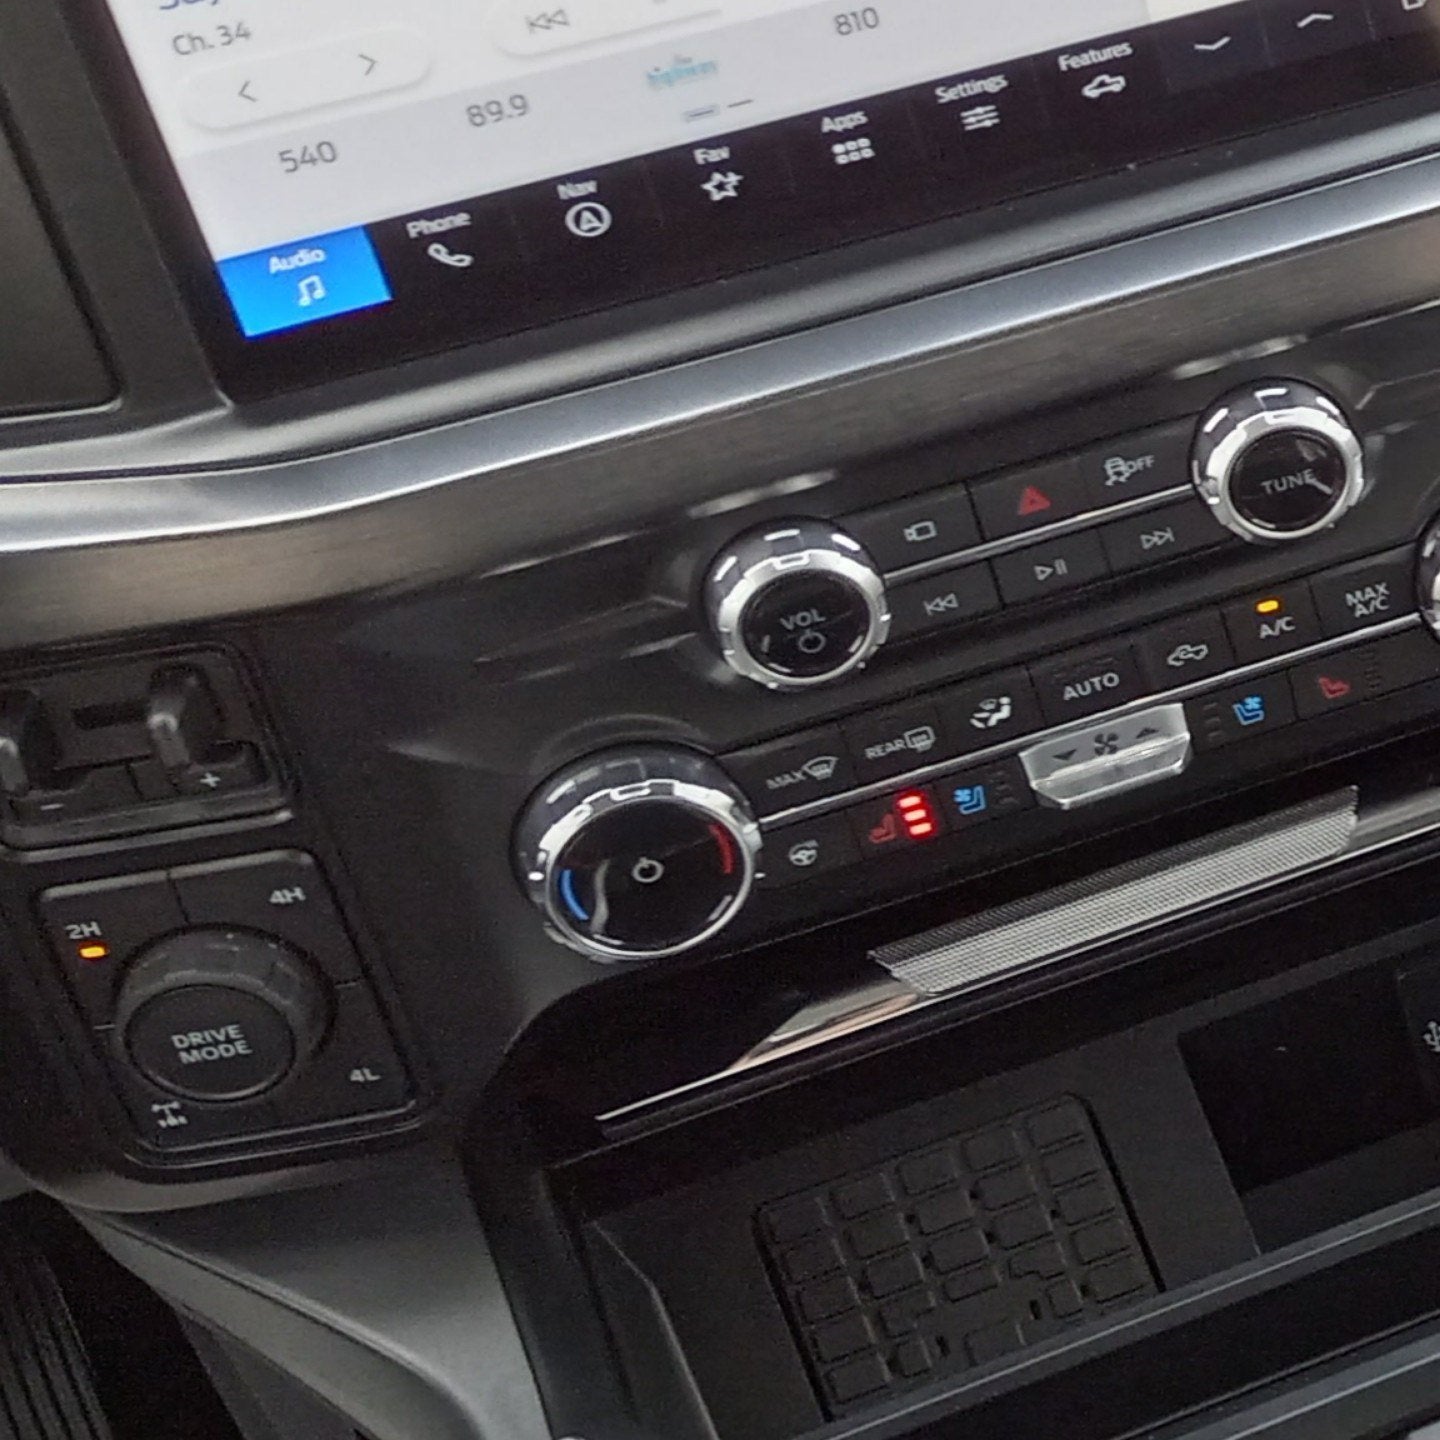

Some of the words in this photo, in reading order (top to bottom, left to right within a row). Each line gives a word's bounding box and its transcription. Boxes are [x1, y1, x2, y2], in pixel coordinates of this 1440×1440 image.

[833, 7, 881, 36] 810
[172, 31, 214, 57] Ch.
[217, 21, 252, 46] 34
[1057, 39, 1133, 71] Features
[934, 70, 1008, 106] Settings
[464, 93, 531, 129] 89.9
[820, 108, 867, 135] Apps
[277, 140, 339, 174] 540
[694, 144, 730, 166] Fav
[556, 177, 598, 200] Nav
[405, 208, 472, 240] Phone
[267, 244, 326, 276] Audio
[1125, 455, 1154, 476] OFF
[1261, 469, 1317, 496] TUNE
[1344, 581, 1391, 609] MAX
[1353, 593, 1390, 619] A/C
[780, 607, 826, 631] VOL
[1258, 616, 1296, 639] A/C
[1062, 672, 1120, 701] AUTO
[865, 738, 905, 761] REAR
[766, 766, 805, 790] MAX
[269, 886, 306, 906] 4H
[65, 921, 102, 940] 2H
[171, 1025, 244, 1049] DRIVE
[179, 1041, 252, 1064] MODE
[349, 1067, 382, 1083] 4L
